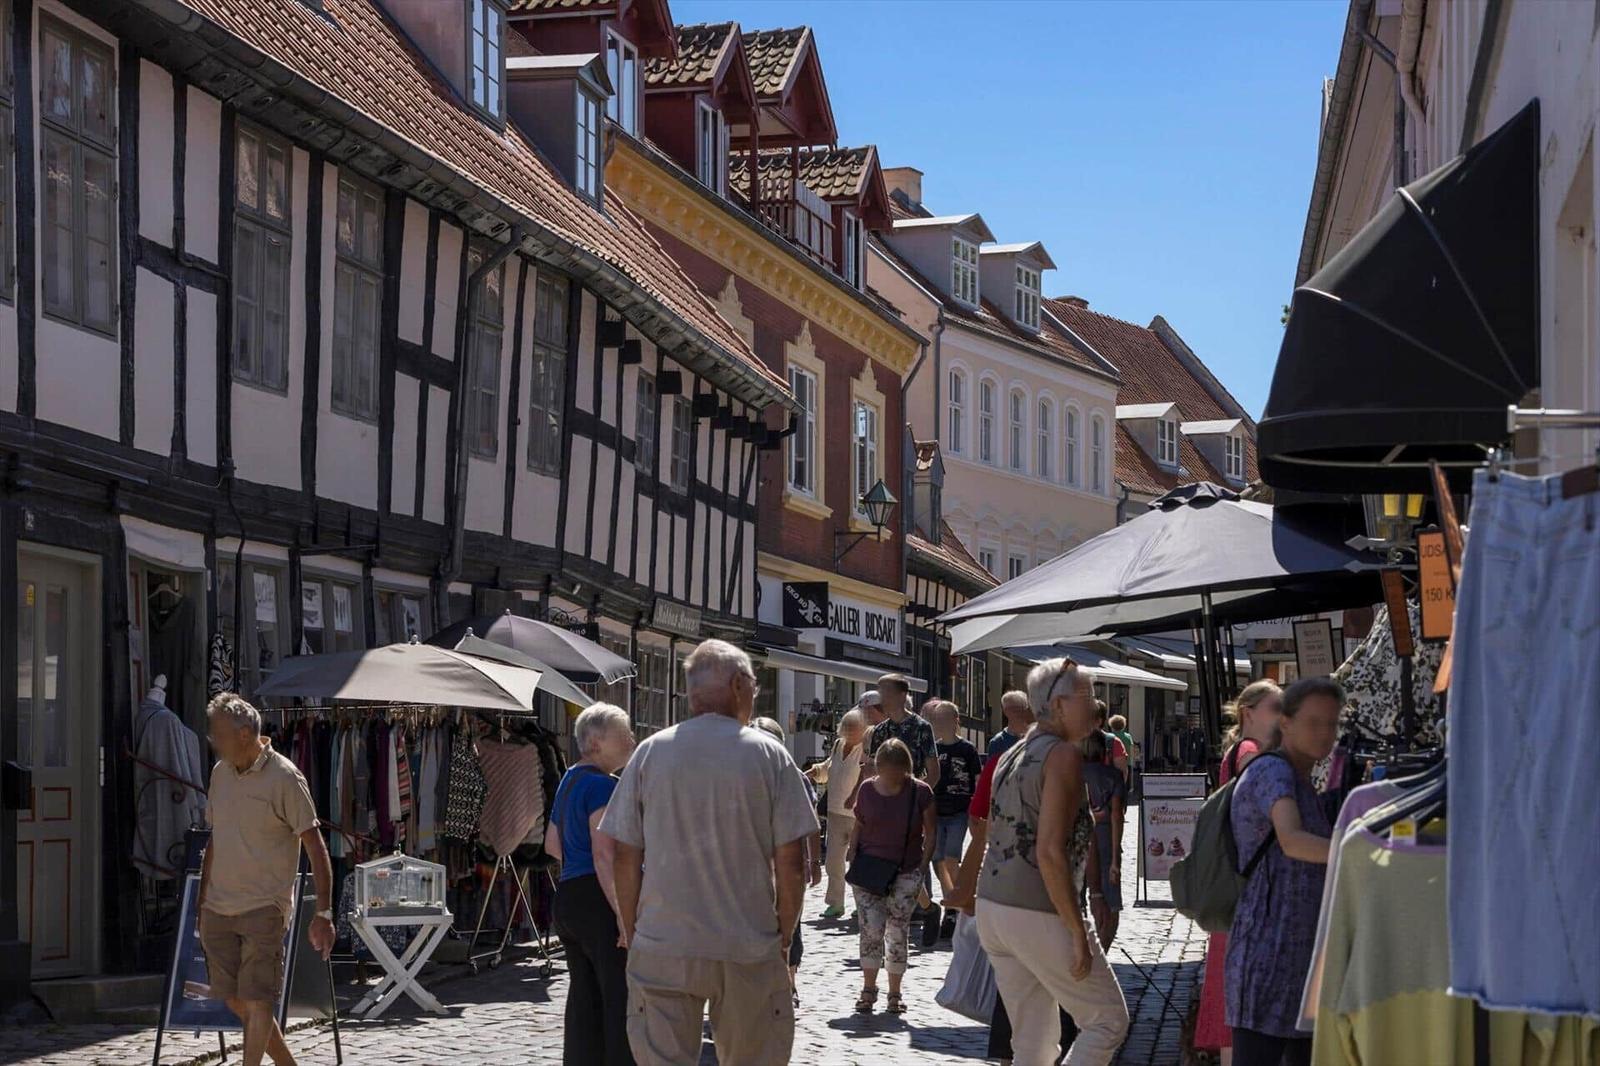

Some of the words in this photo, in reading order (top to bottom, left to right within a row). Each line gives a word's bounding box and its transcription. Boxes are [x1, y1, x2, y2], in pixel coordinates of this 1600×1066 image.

[785, 585, 800, 600] SKO
[1425, 587, 1442, 602] 150
[828, 601, 860, 636] GALLERI
